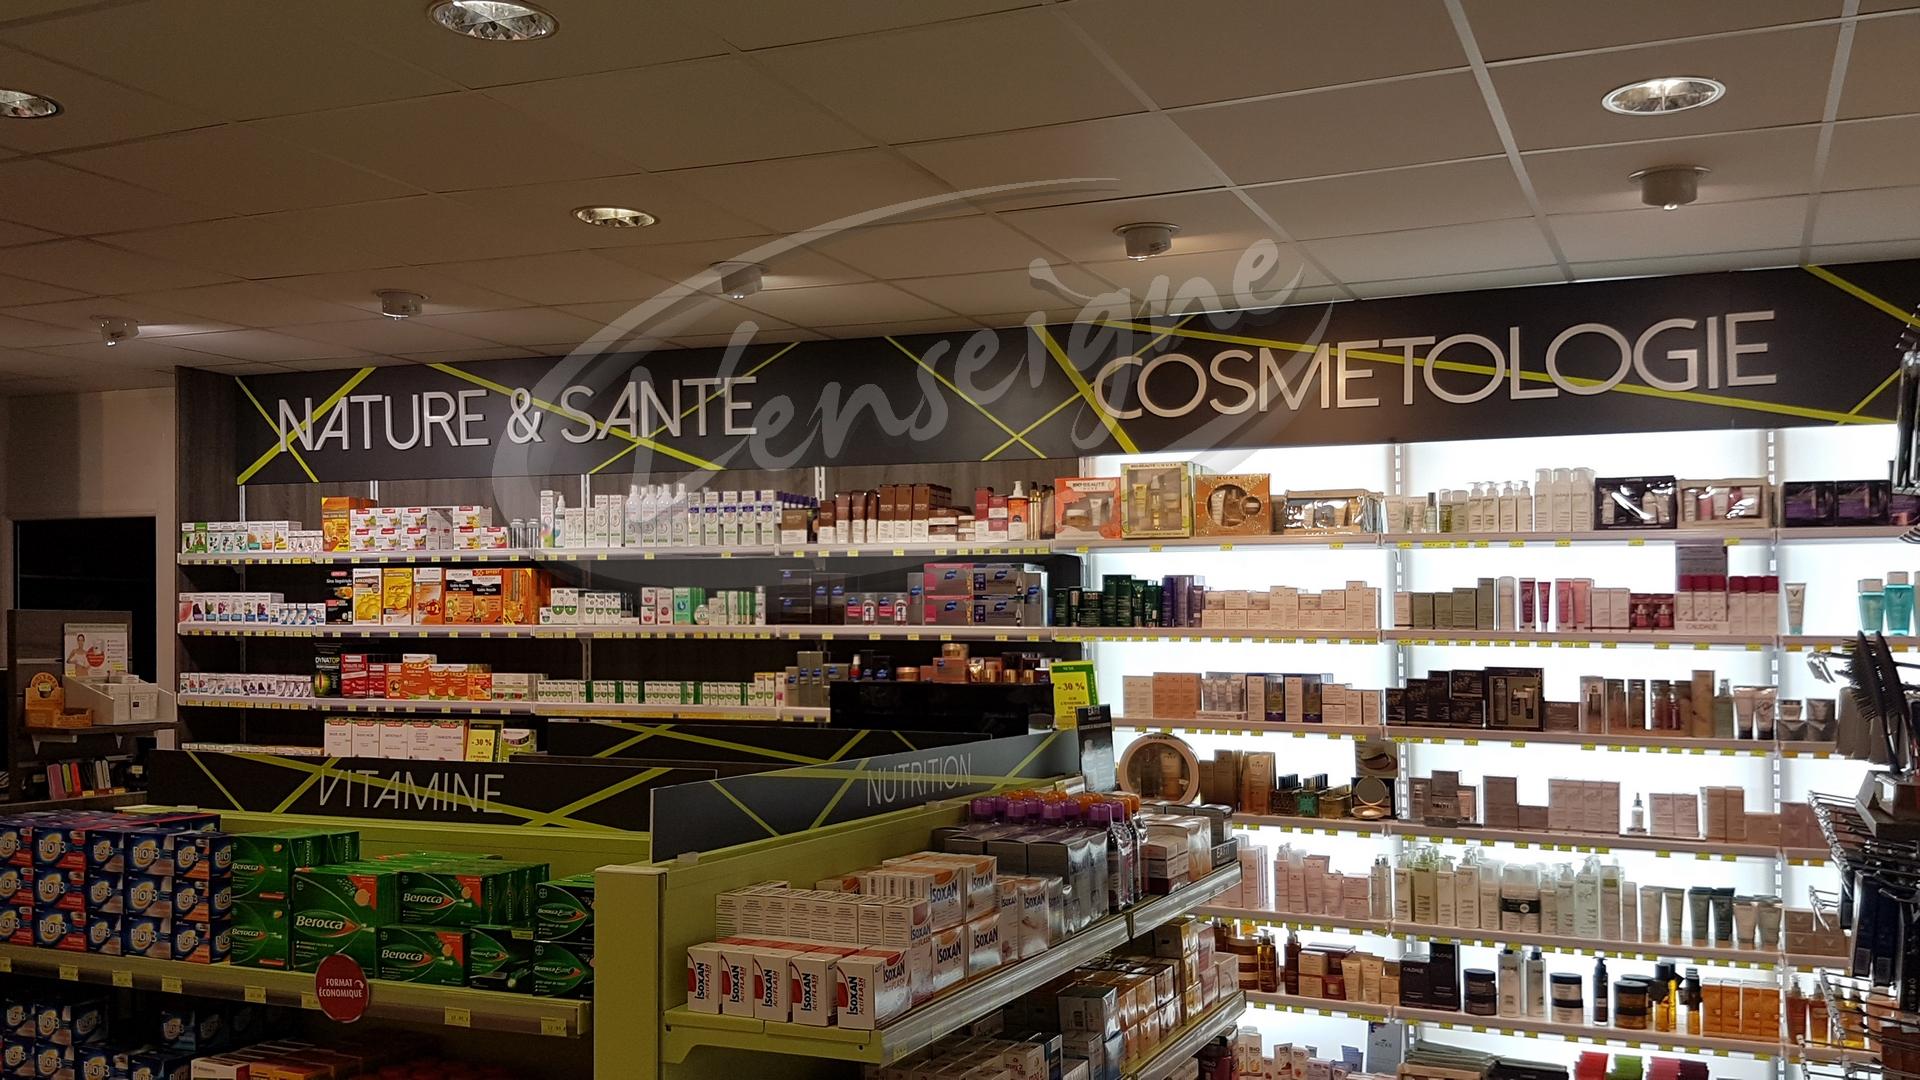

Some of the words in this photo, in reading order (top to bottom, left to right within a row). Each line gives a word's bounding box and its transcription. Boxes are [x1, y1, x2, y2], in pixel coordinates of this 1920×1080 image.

[1094, 309, 1778, 420] COSMETOLOGIE
[278, 388, 489, 453] NATURE
[507, 388, 543, 444] &
[562, 376, 758, 442] SANTE
[314, 656, 340, 664] DYNATOP
[867, 752, 971, 807] NUTRITION
[320, 769, 504, 814] VITAMINE
[232, 862, 259, 872] Berocca
[402, 893, 442, 904] Berocca
[296, 915, 344, 930] Berocca
[232, 928, 259, 938] Berocca
[382, 950, 423, 962] Berocca
[326, 978, 353, 987] FORMAT
[318, 988, 363, 1000] ÉCONOMIQUE
